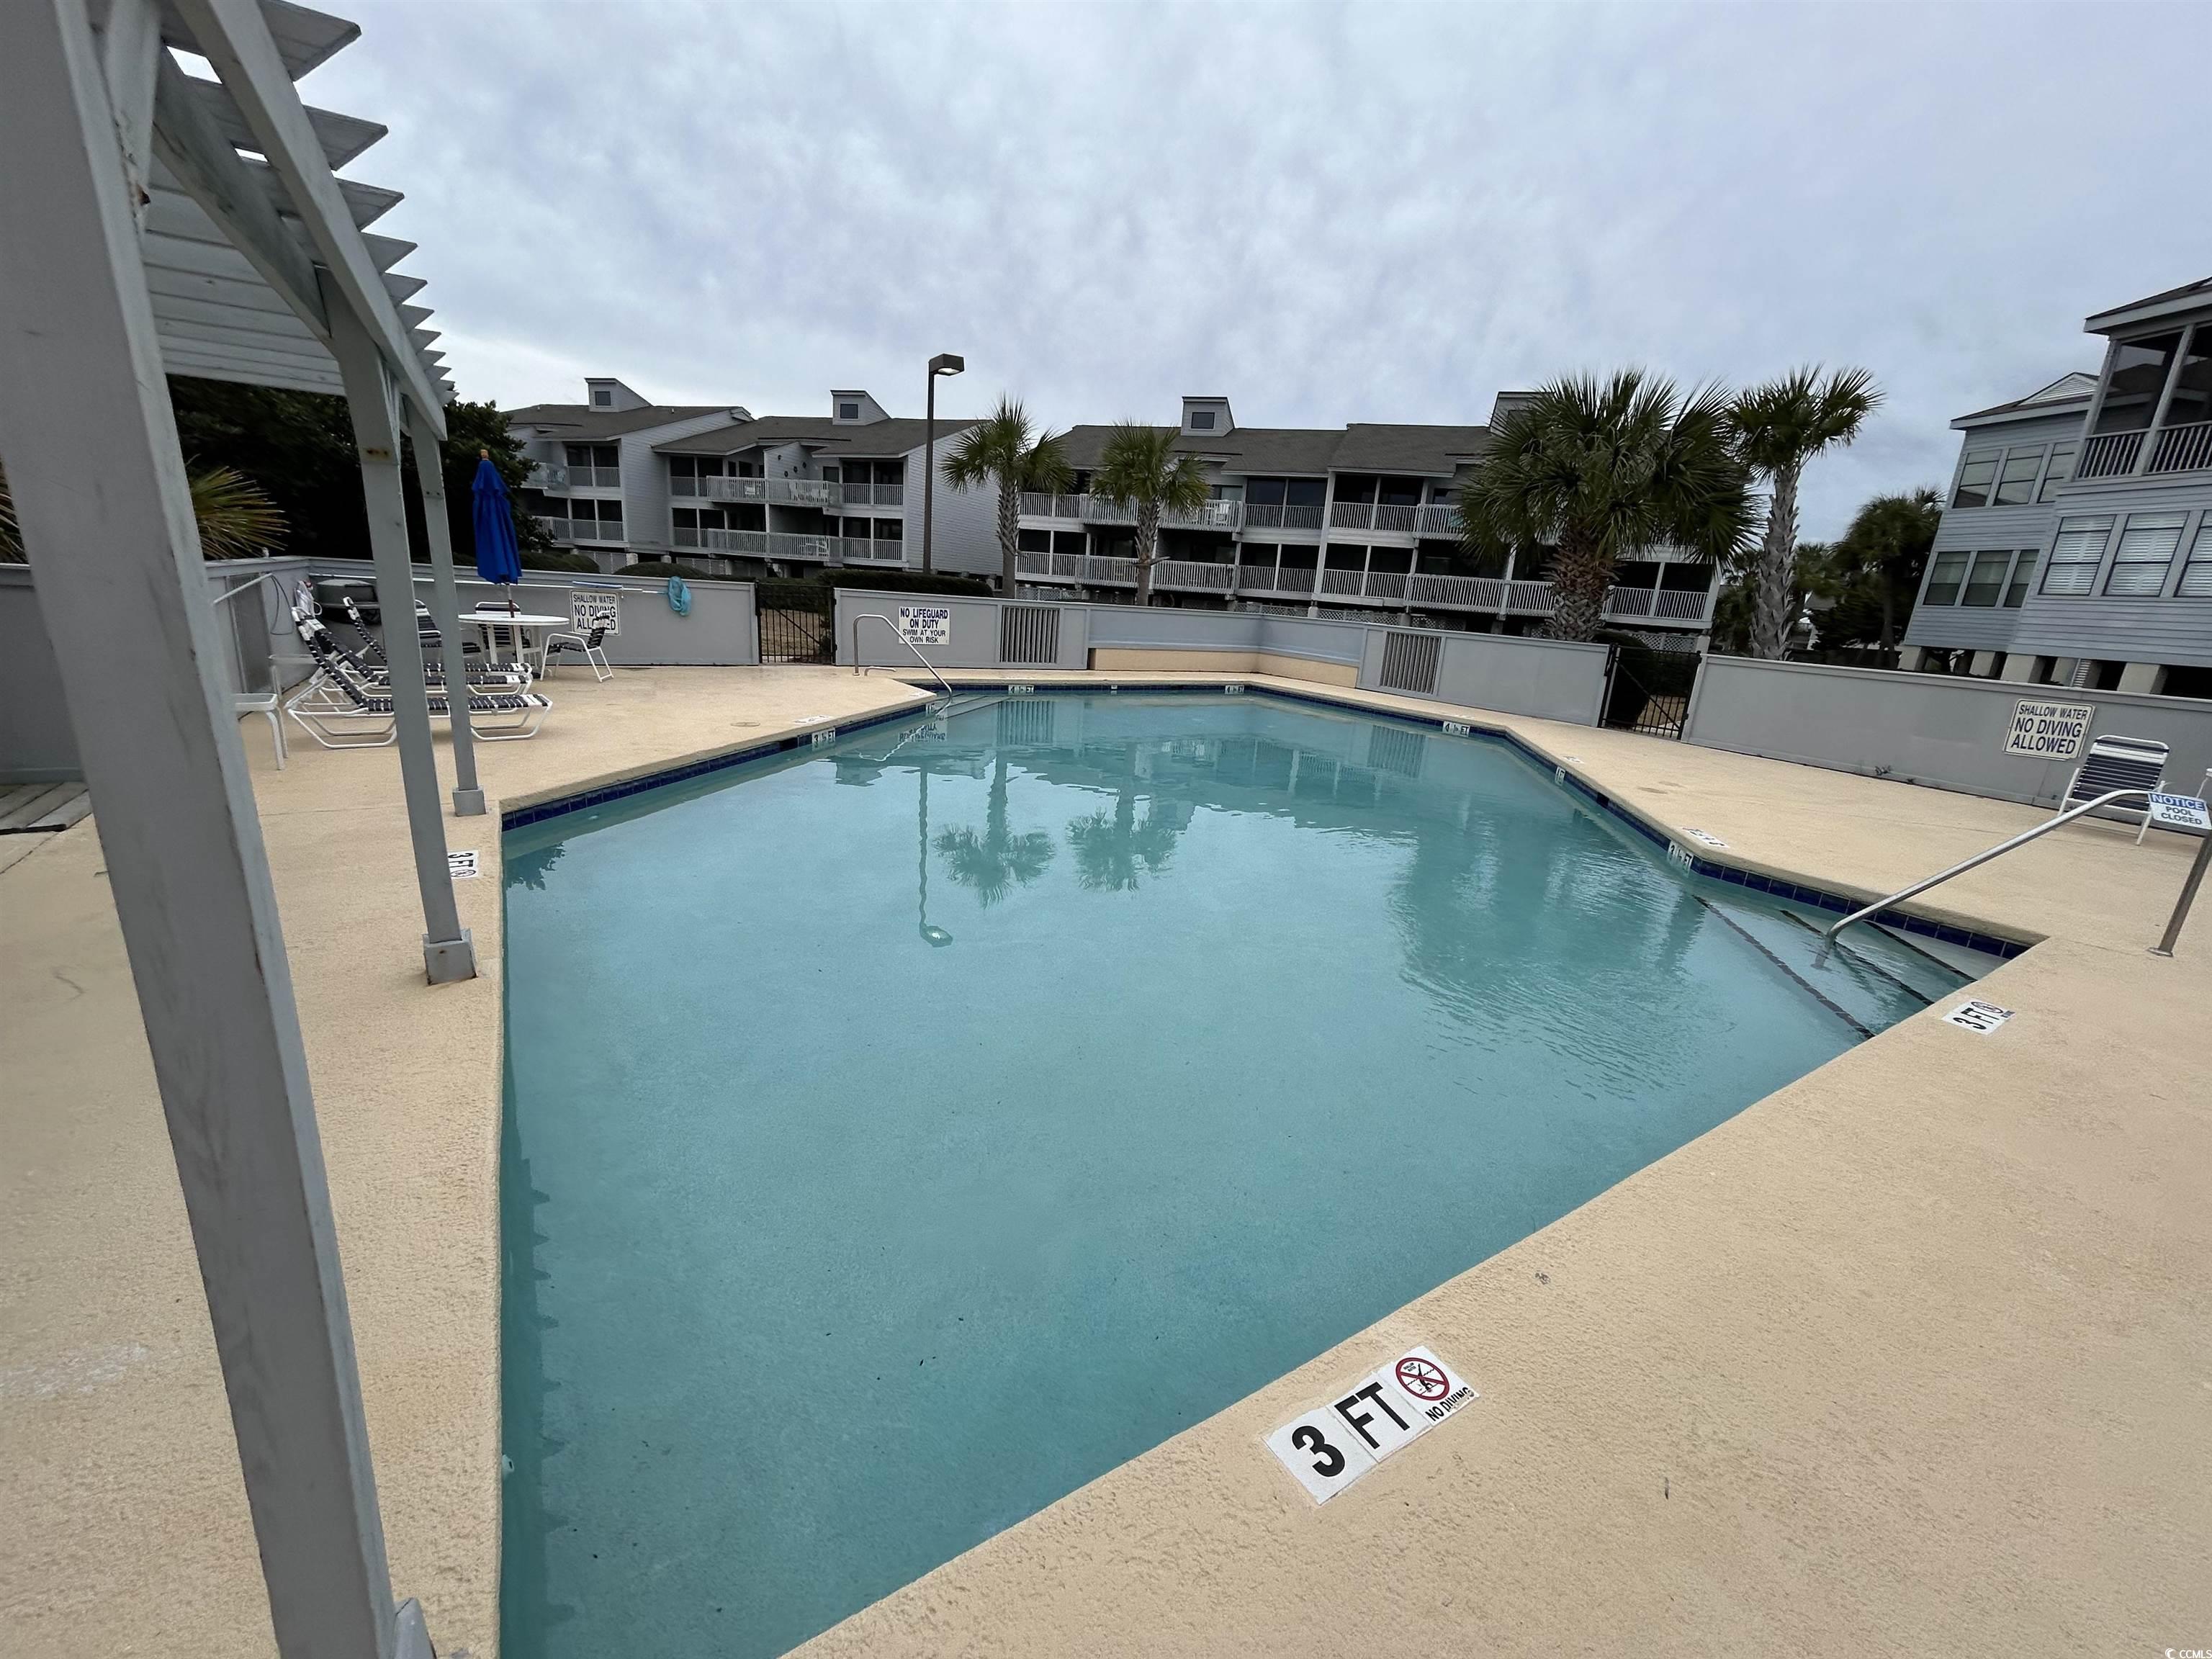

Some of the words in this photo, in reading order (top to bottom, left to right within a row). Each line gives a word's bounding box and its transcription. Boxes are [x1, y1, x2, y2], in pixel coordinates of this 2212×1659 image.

[573, 594, 597, 603] SHALLOW
[599, 595, 615, 604] WATER
[574, 604, 586, 616] NO
[900, 608, 910, 618] NO
[913, 608, 948, 619] LIFEGUARD
[909, 619, 919, 629] ON
[922, 619, 939, 629] DUTY
[2019, 704, 2058, 717] SHALLOW
[2059, 707, 2087, 720] WATER
[2014, 717, 2033, 733] NO
[2036, 719, 2083, 738] DIVING
[2010, 734, 2076, 755] ALLOWED
[2152, 794, 2204, 810] NOTICE
[2161, 812, 2202, 825] CLOSED
[2165, 806, 2195, 817] POOL
[1961, 1007, 2000, 1025] FT
[1953, 1017, 1987, 1030] 3
[1425, 1406, 1444, 1422] NO
[1291, 1425, 1346, 1478] 3
[1334, 1381, 1411, 1449] FT
